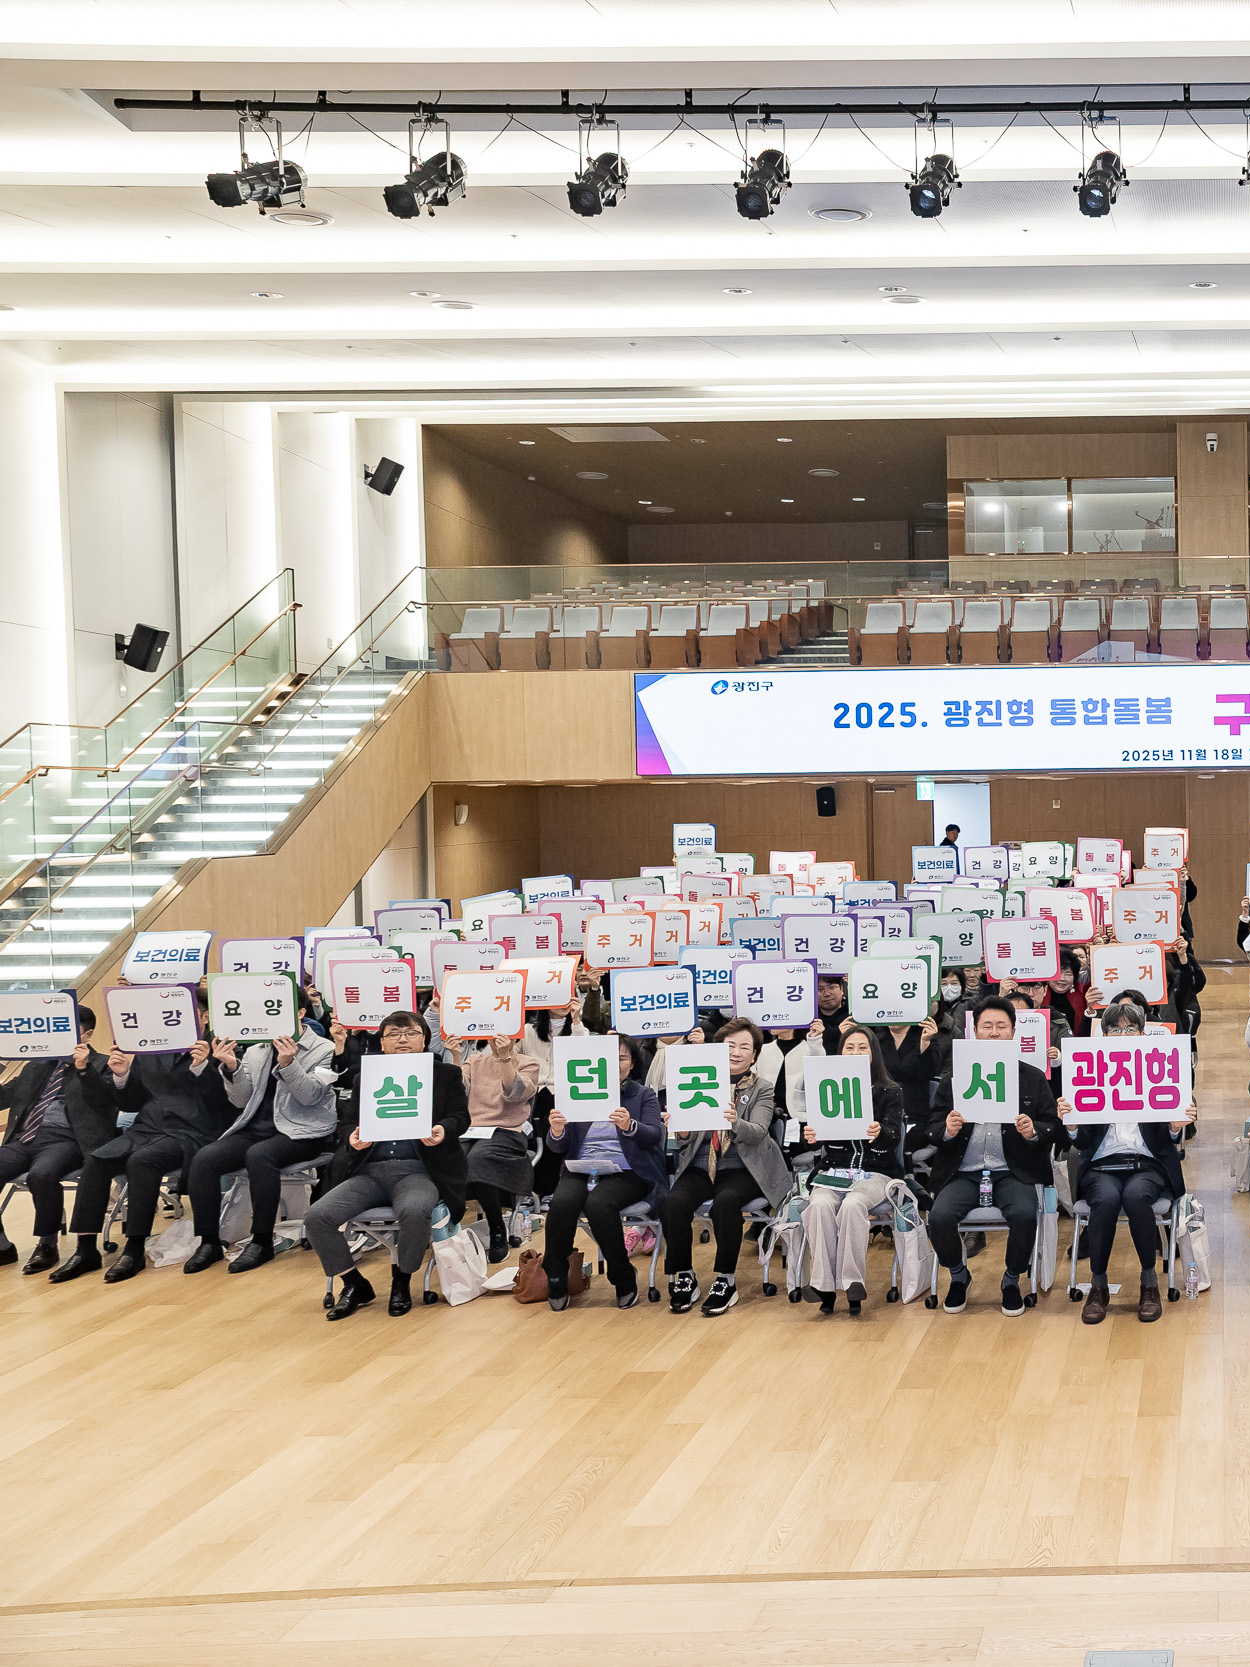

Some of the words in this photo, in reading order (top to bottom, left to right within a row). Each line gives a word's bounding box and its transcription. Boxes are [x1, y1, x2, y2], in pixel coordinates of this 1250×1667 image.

[732, 681, 774, 693] 광진구
[833, 703, 928, 729] 2025.
[943, 700, 1034, 728] 광진형
[1049, 696, 1173, 727] 통합돌봄
[1122, 749, 1174, 763] 2025년
[1180, 748, 1207, 761] 11월
[1213, 747, 1242, 761] 18일
[678, 838, 712, 846] 보건의료
[917, 860, 954, 870] 보건의료
[1013, 862, 1021, 871] 강
[471, 919, 484, 932] 요
[699, 921, 711, 932] 거
[666, 930, 678, 943] 거
[959, 932, 973, 946] 양
[133, 948, 201, 962] 보건의료
[547, 971, 562, 984] 거
[620, 992, 689, 1012] 보건의료
[1020, 1036, 1036, 1053] 봄
[567, 1057, 608, 1101] 던
[962, 1061, 1006, 1103] 서
[1072, 1047, 1181, 1113] 광진형
[678, 1065, 720, 1110] 곳
[373, 1074, 423, 1119] 살
[818, 1077, 863, 1119] 에
